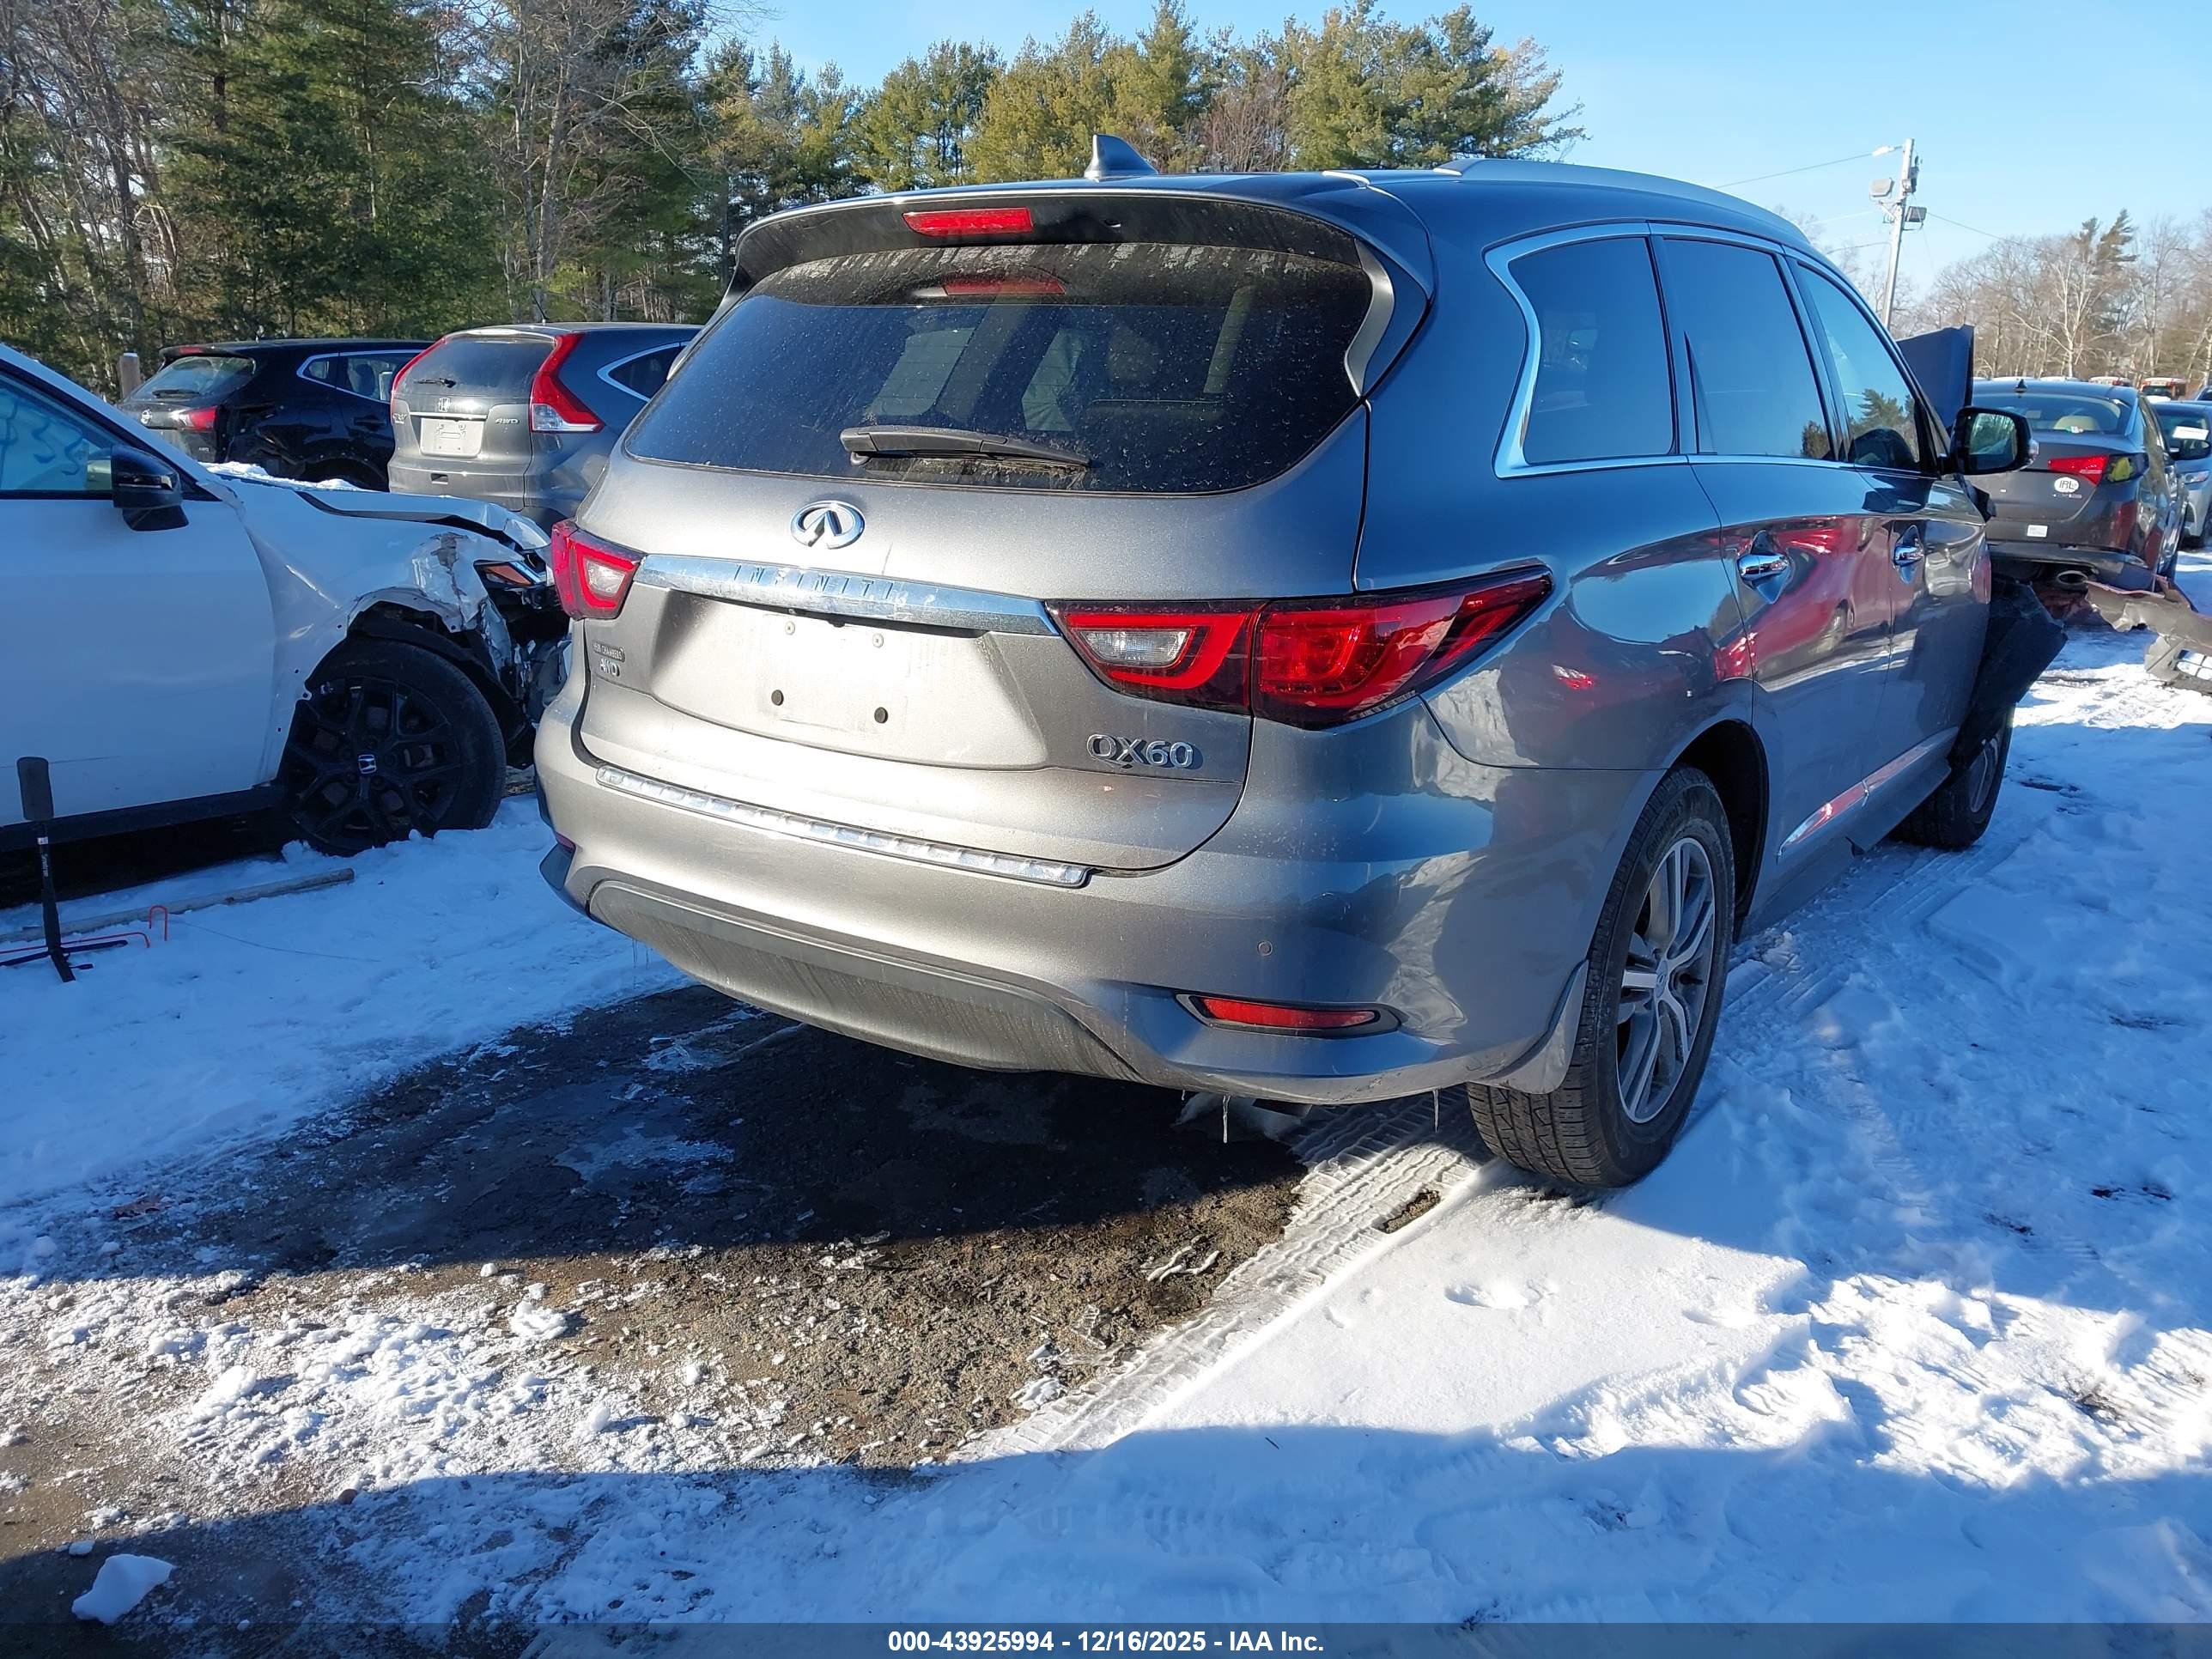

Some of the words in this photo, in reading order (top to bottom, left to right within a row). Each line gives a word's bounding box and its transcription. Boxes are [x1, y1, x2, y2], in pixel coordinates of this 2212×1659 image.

[2058, 480, 2075, 490] IRL
[734, 563, 894, 600] INFINITI
[599, 658, 617, 676] AWD
[1086, 733, 1194, 769] QX60
